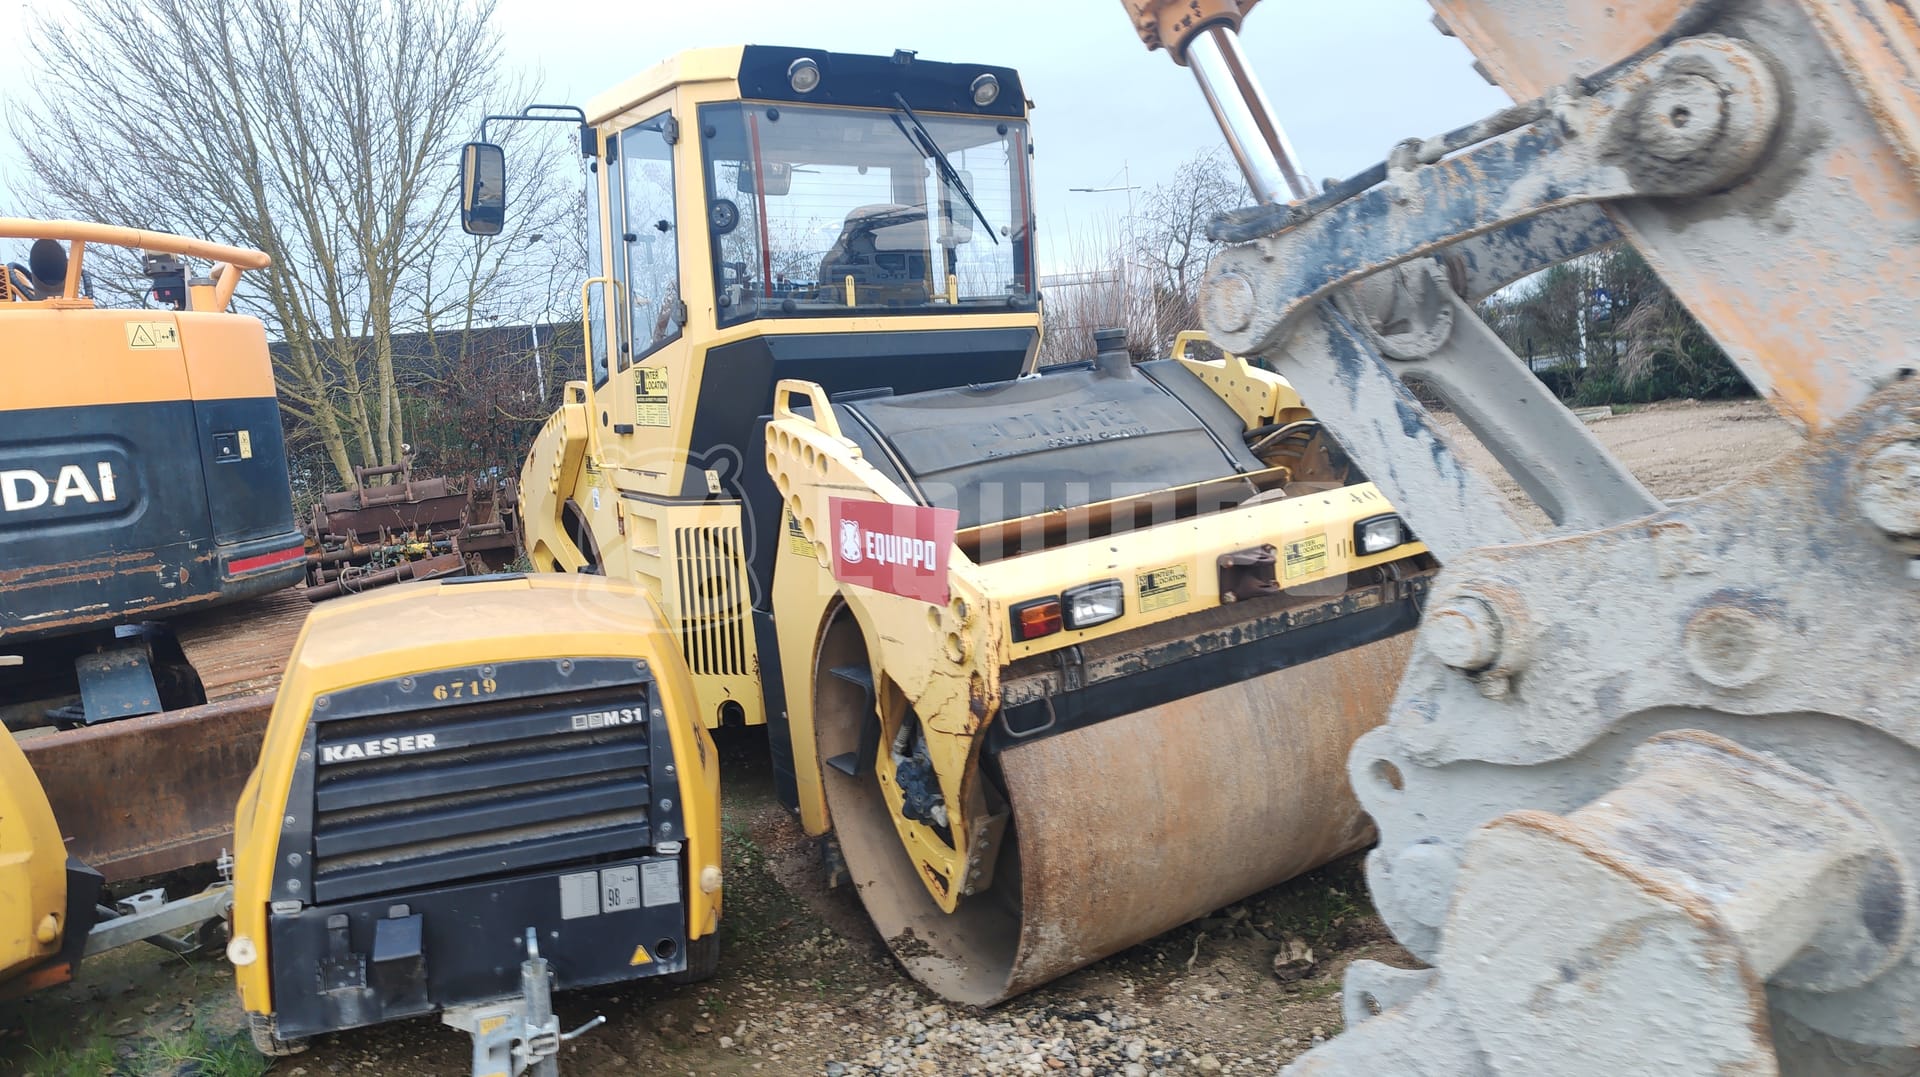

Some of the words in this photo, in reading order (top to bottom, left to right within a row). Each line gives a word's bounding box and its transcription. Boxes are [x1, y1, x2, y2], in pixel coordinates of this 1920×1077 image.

[646, 380, 668, 390] LOCATION
[0, 461, 117, 512] DAI
[864, 530, 937, 572] EQUIPPO
[432, 678, 497, 701] 6719
[322, 733, 437, 763] KAESER
[608, 888, 621, 907] 98
